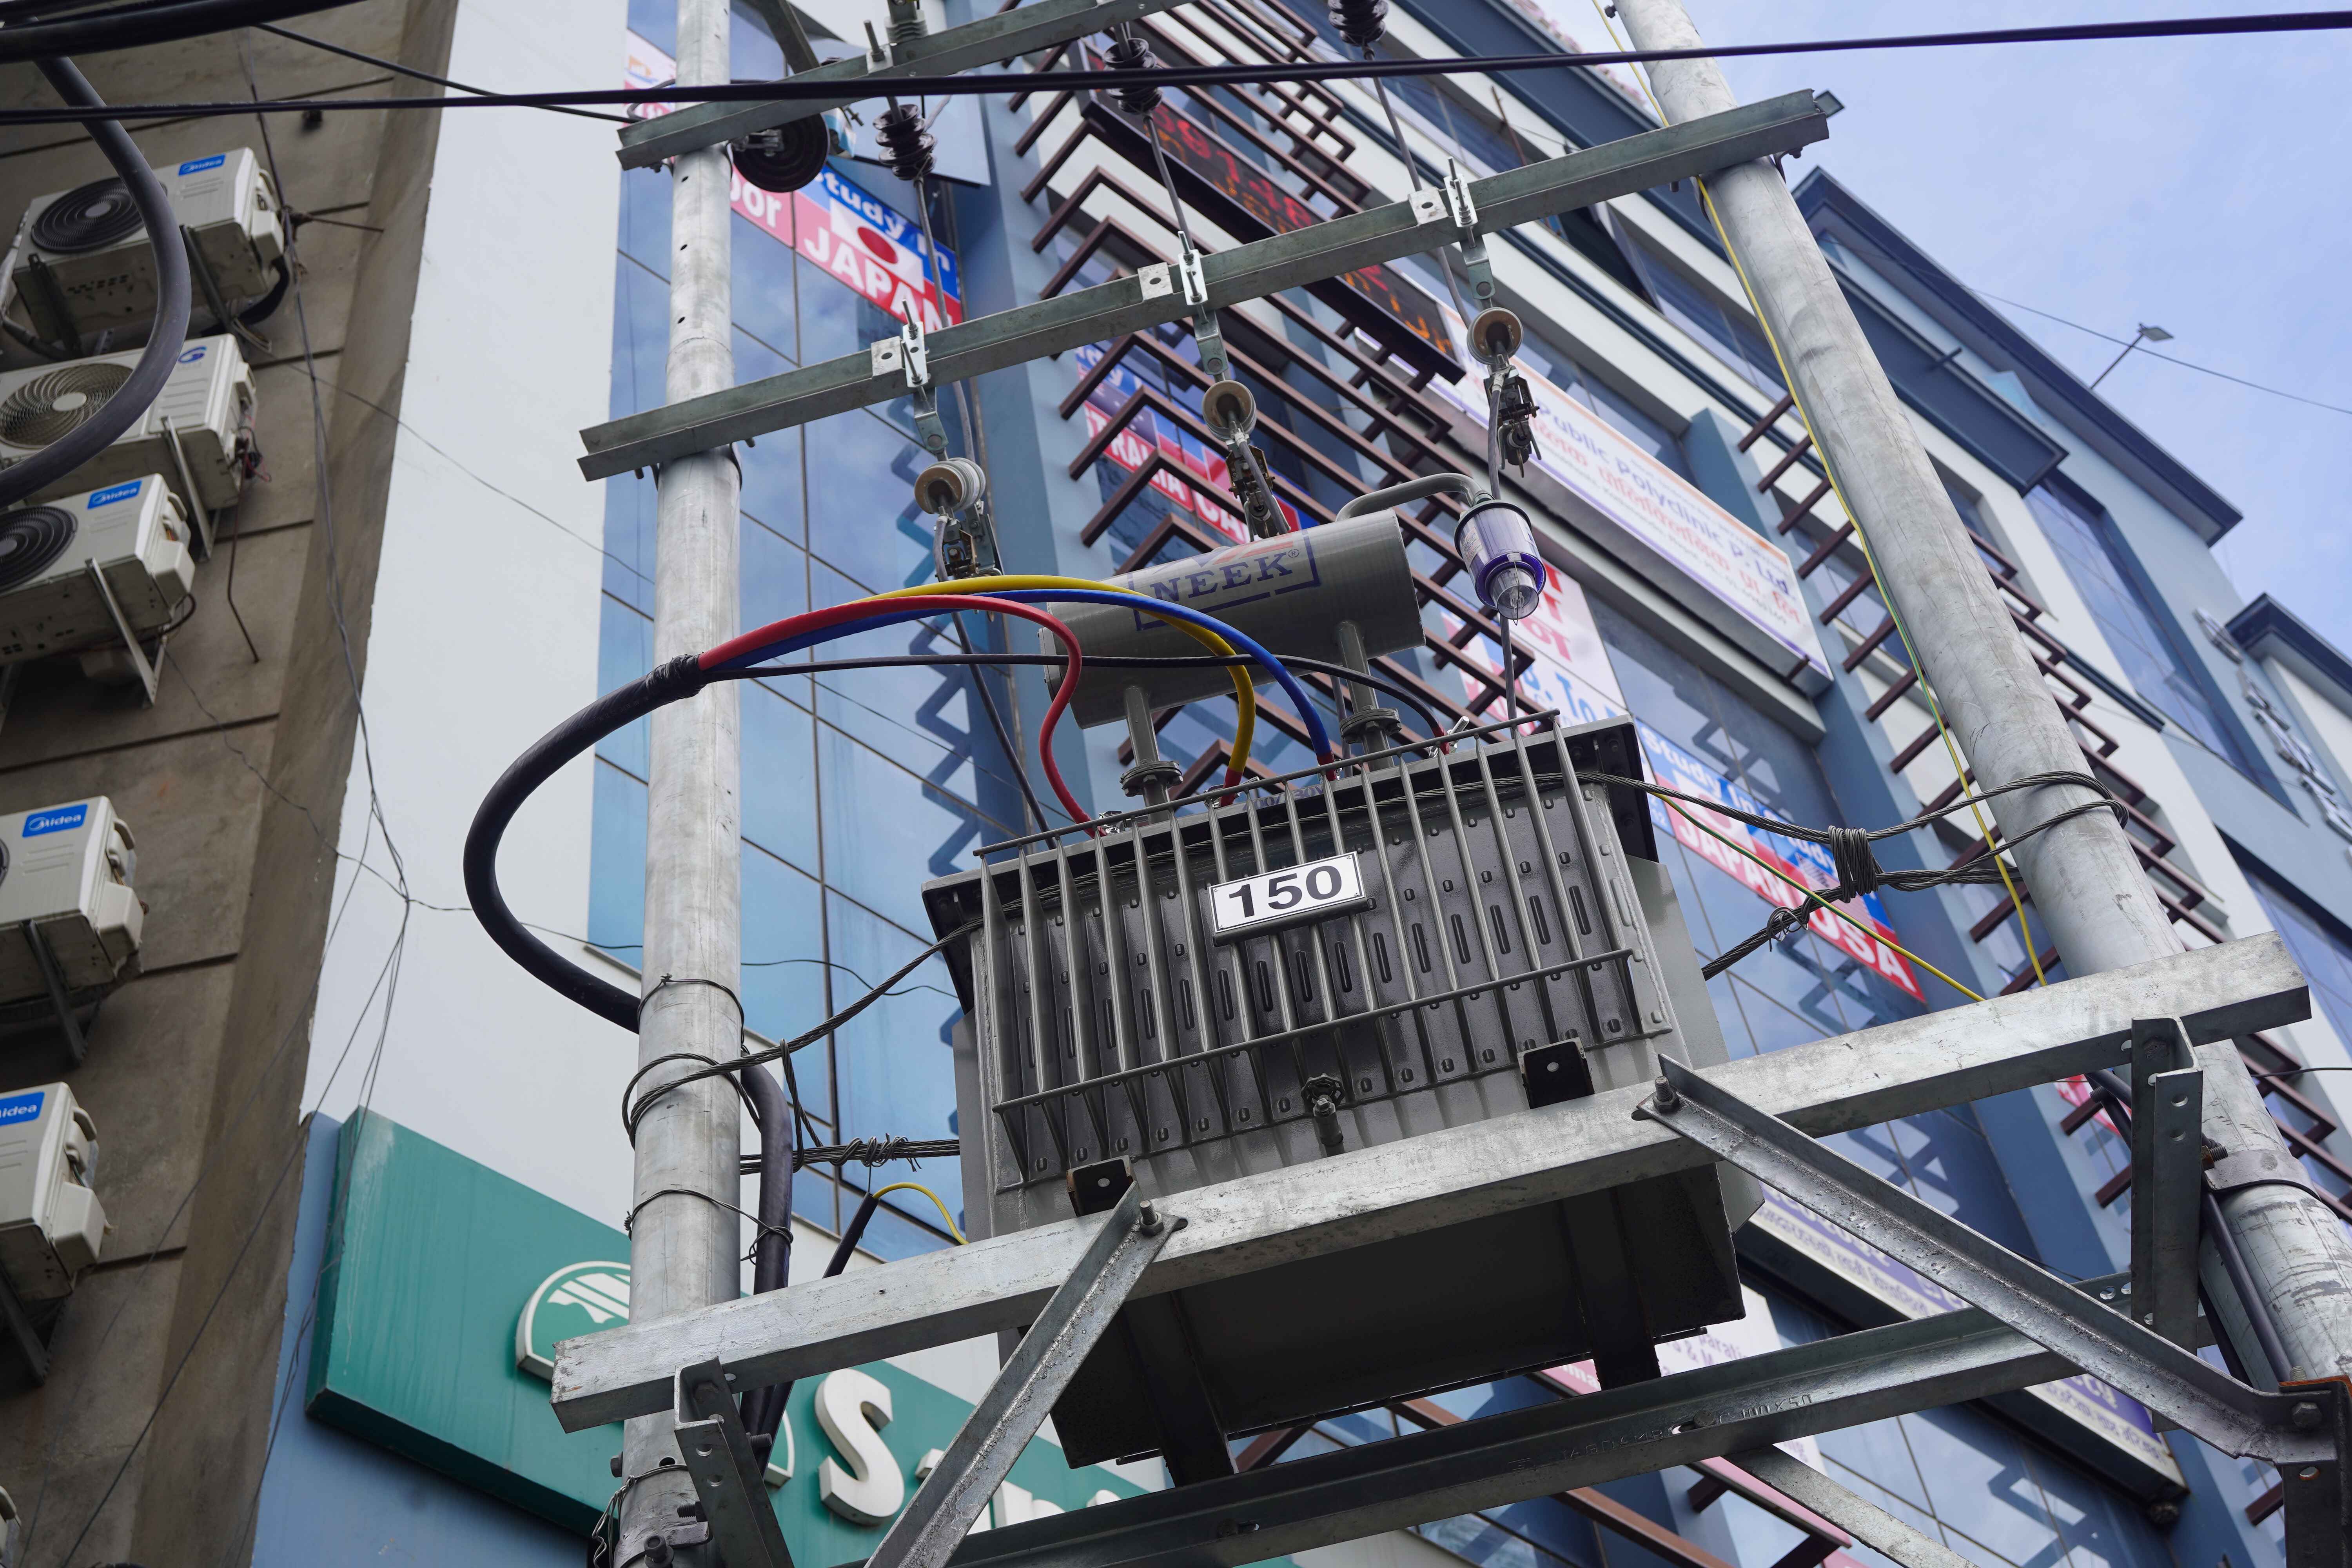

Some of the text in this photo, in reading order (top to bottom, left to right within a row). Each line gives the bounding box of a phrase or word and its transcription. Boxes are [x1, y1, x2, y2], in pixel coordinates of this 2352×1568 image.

[814, 171, 905, 239] tudy
[1615, 456, 1723, 548] Polyclinic
[1640, 726, 1722, 799] Study
[29, 814, 82, 831] Midea
[1229, 865, 1342, 918] 150
[1679, 816, 1807, 909] JAPAN
[1808, 902, 1918, 993] USA
[0, 1104, 38, 1118] idea
